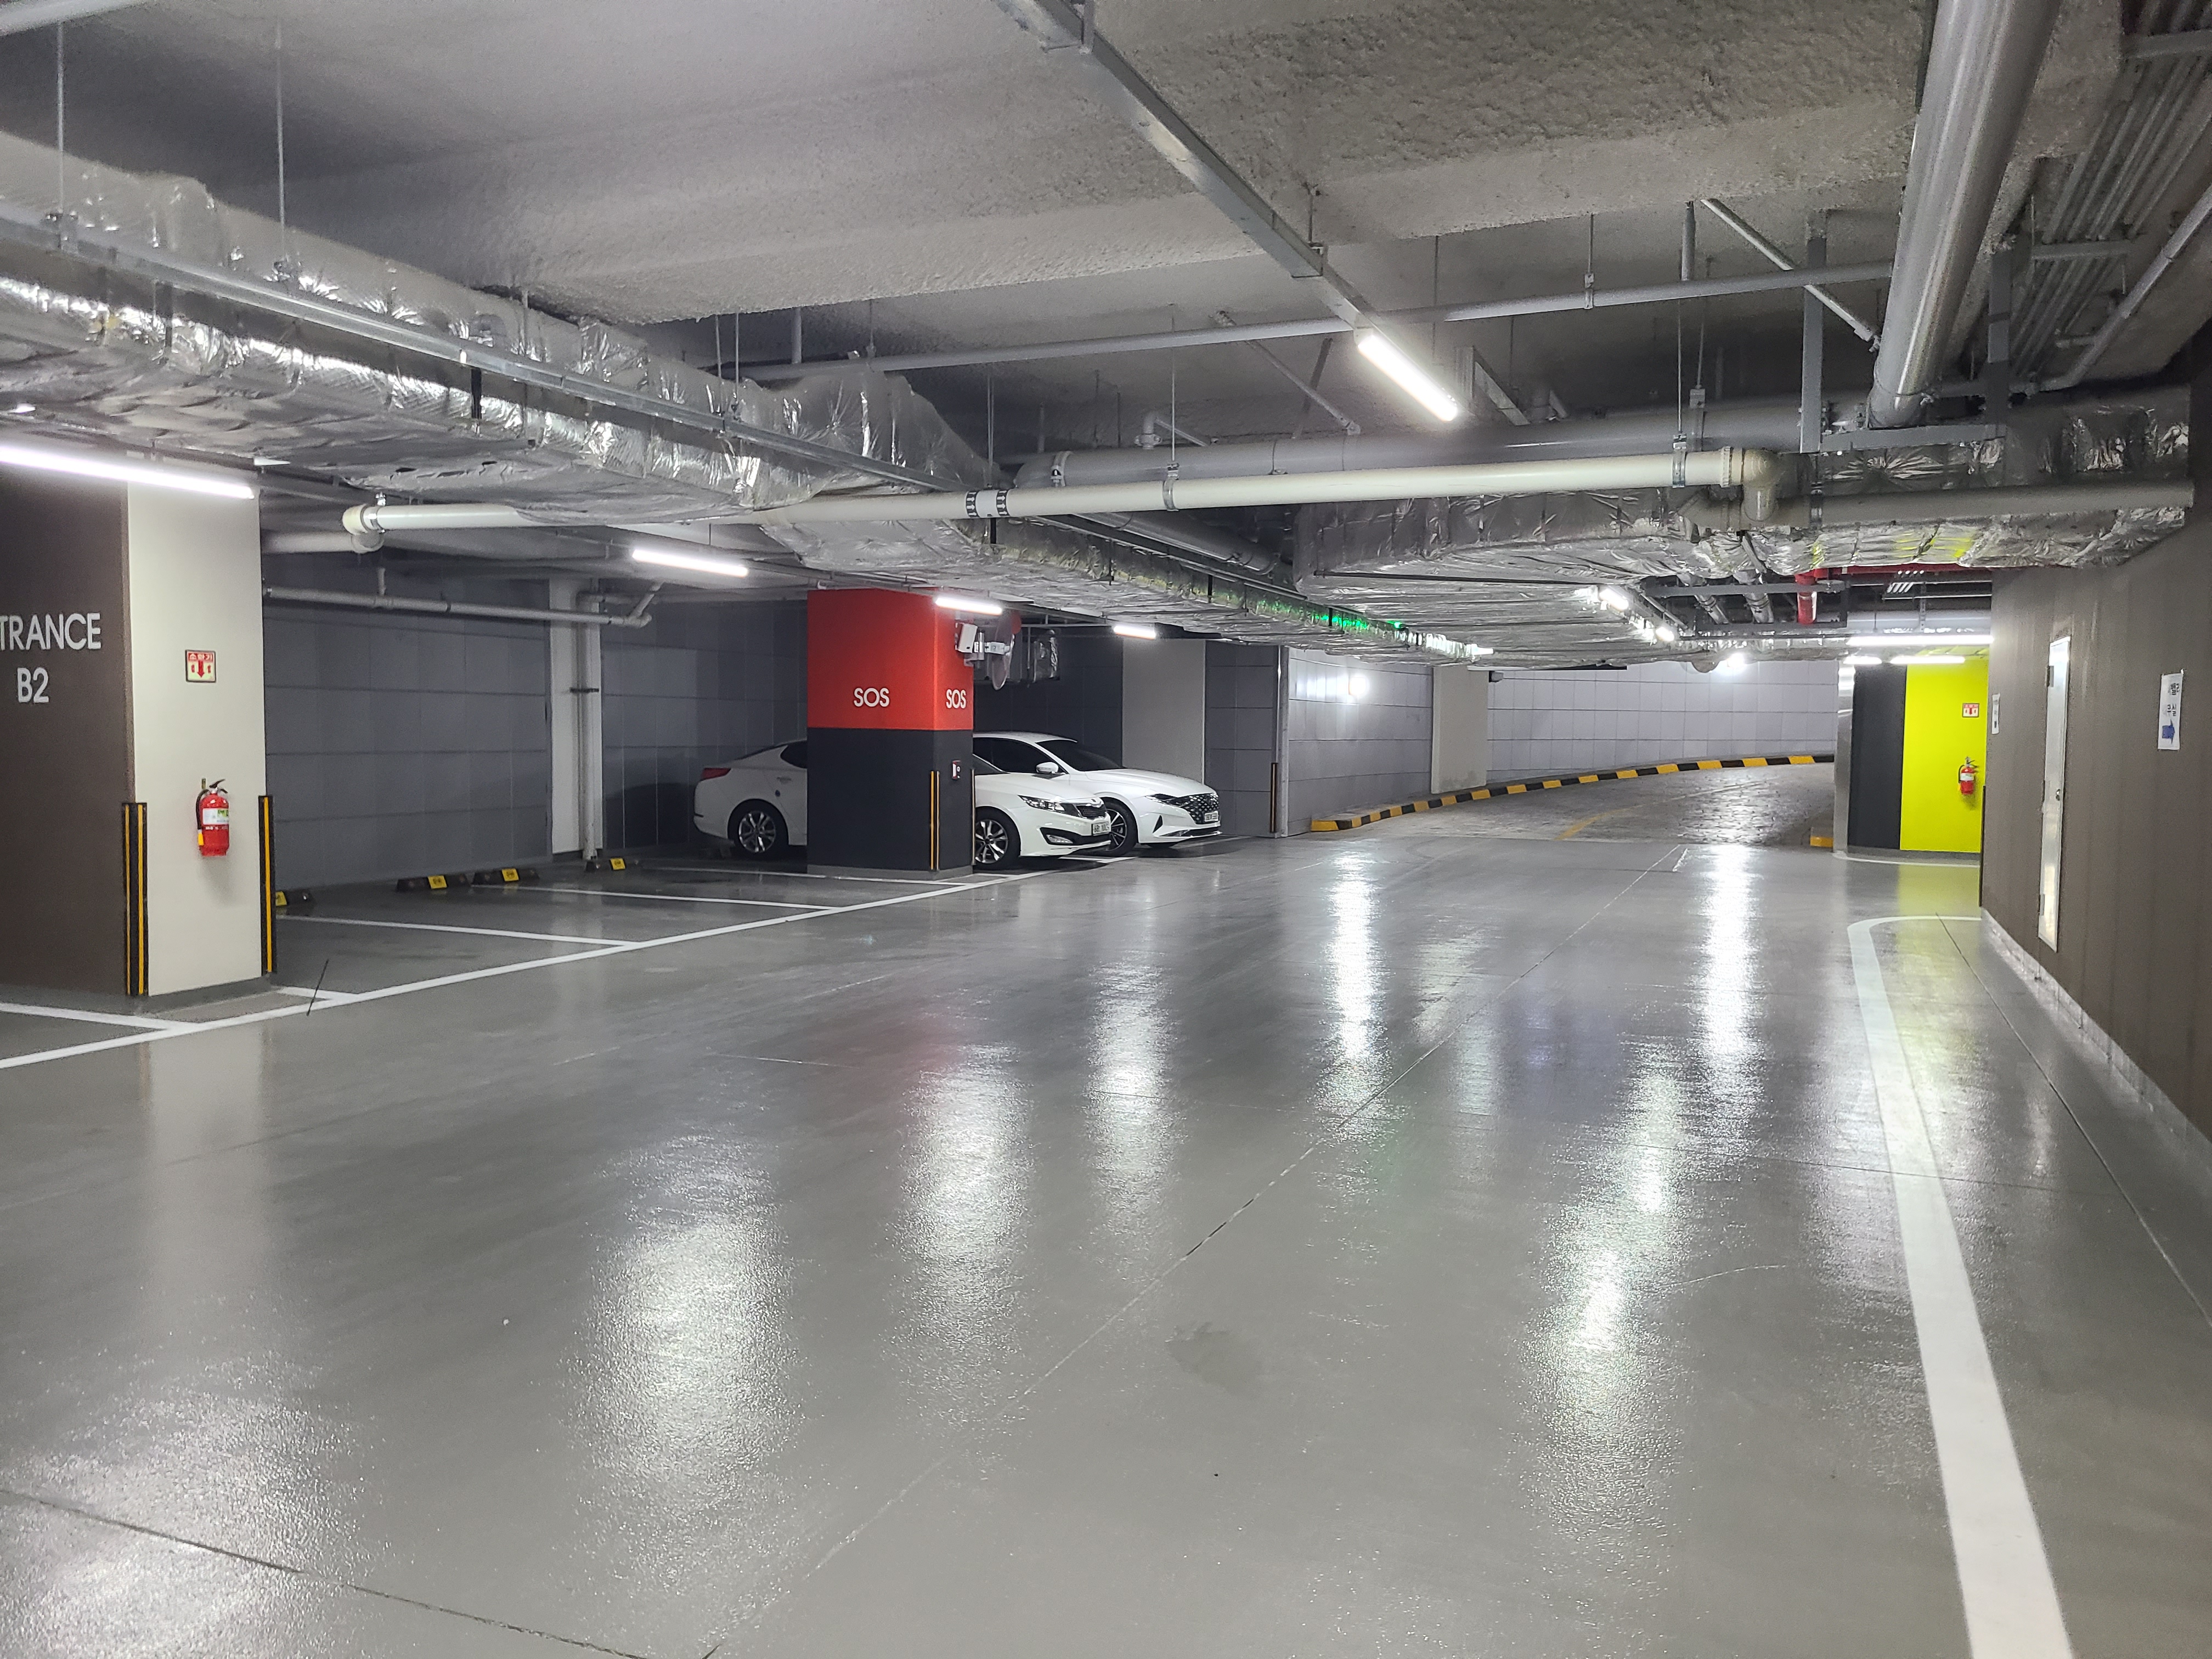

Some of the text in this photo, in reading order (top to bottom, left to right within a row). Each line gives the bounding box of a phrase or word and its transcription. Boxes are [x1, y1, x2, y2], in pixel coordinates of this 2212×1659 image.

[0, 612, 101, 650] TRANCE
[17, 667, 49, 703] B2
[853, 687, 890, 707] SOS
[946, 689, 967, 709] SOS
